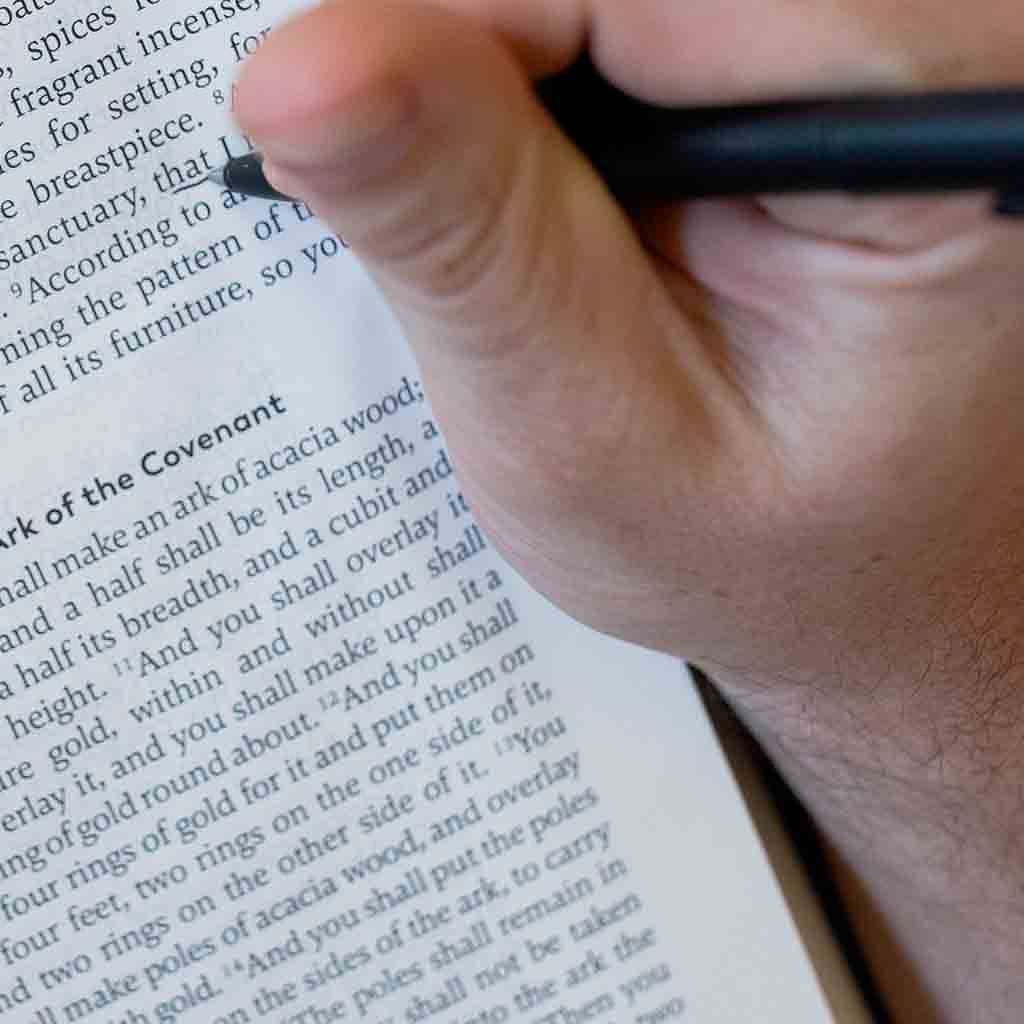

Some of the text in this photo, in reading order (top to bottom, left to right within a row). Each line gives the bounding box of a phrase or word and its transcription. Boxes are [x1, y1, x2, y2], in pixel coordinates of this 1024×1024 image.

[10, 45, 132, 118] fragrant
[20, 364, 57, 404] all
[62, 350, 103, 382] its
[109, 282, 253, 359] furniture,
[45, 491, 75, 526] of
[81, 473, 135, 506] the
[140, 394, 287, 477] Covenant
[51, 529, 129, 580] make
[133, 511, 169, 540] an
[173, 480, 219, 520] ark
[221, 459, 249, 495] of
[254, 426, 341, 480] acacia
[341, 376, 424, 435] wood;
[128, 669, 224, 723] within
[238, 626, 292, 674] and
[304, 572, 414, 638] without
[427, 524, 486, 578] shall
[62, 975, 139, 1023] make
[143, 938, 217, 991] poles
[220, 911, 249, 946] of
[255, 877, 339, 931] acacia
[430, 797, 483, 843] and
[487, 751, 580, 813] overlay
